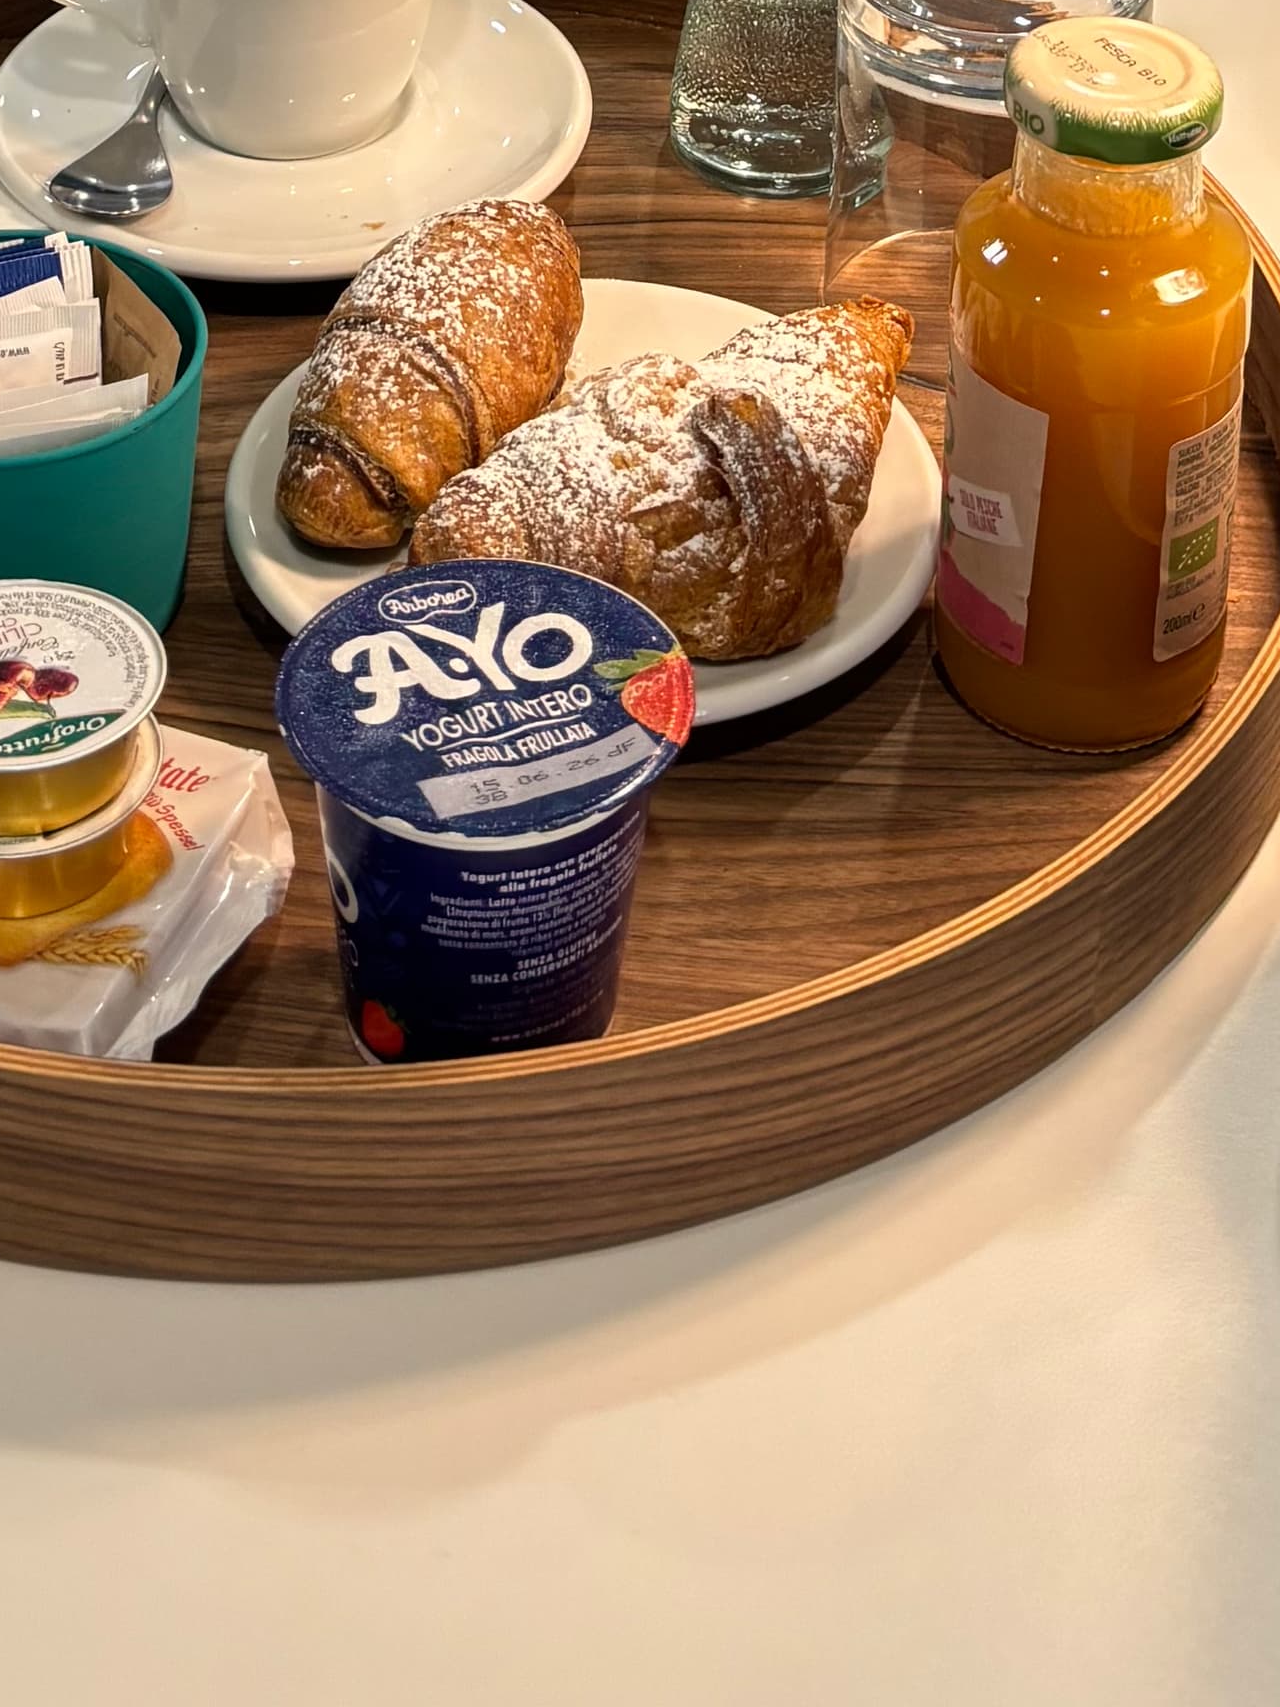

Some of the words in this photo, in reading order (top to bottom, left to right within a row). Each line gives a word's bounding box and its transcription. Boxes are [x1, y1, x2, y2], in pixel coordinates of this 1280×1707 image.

[1094, 37, 1137, 68] PESCA
[1138, 68, 1167, 86] BIO
[1013, 101, 1044, 135] BIO
[976, 495, 1003, 519] PESCHE
[967, 510, 999, 536] ITALIANE
[386, 586, 471, 615] Arborea
[402, 702, 503, 751] YOGURT
[503, 684, 592, 722] INTERO
[441, 745, 519, 768] FRAGOLA
[519, 722, 597, 759] FRULLATA
[475, 790, 508, 805] 3B
[461, 871, 507, 884] Yogurt
[555, 858, 574, 870] con
[499, 882, 526, 893] alla
[530, 868, 576, 889] fragola
[579, 844, 617, 873] frullata
[517, 953, 553, 970] SENZA
[471, 973, 509, 984] SENZA
